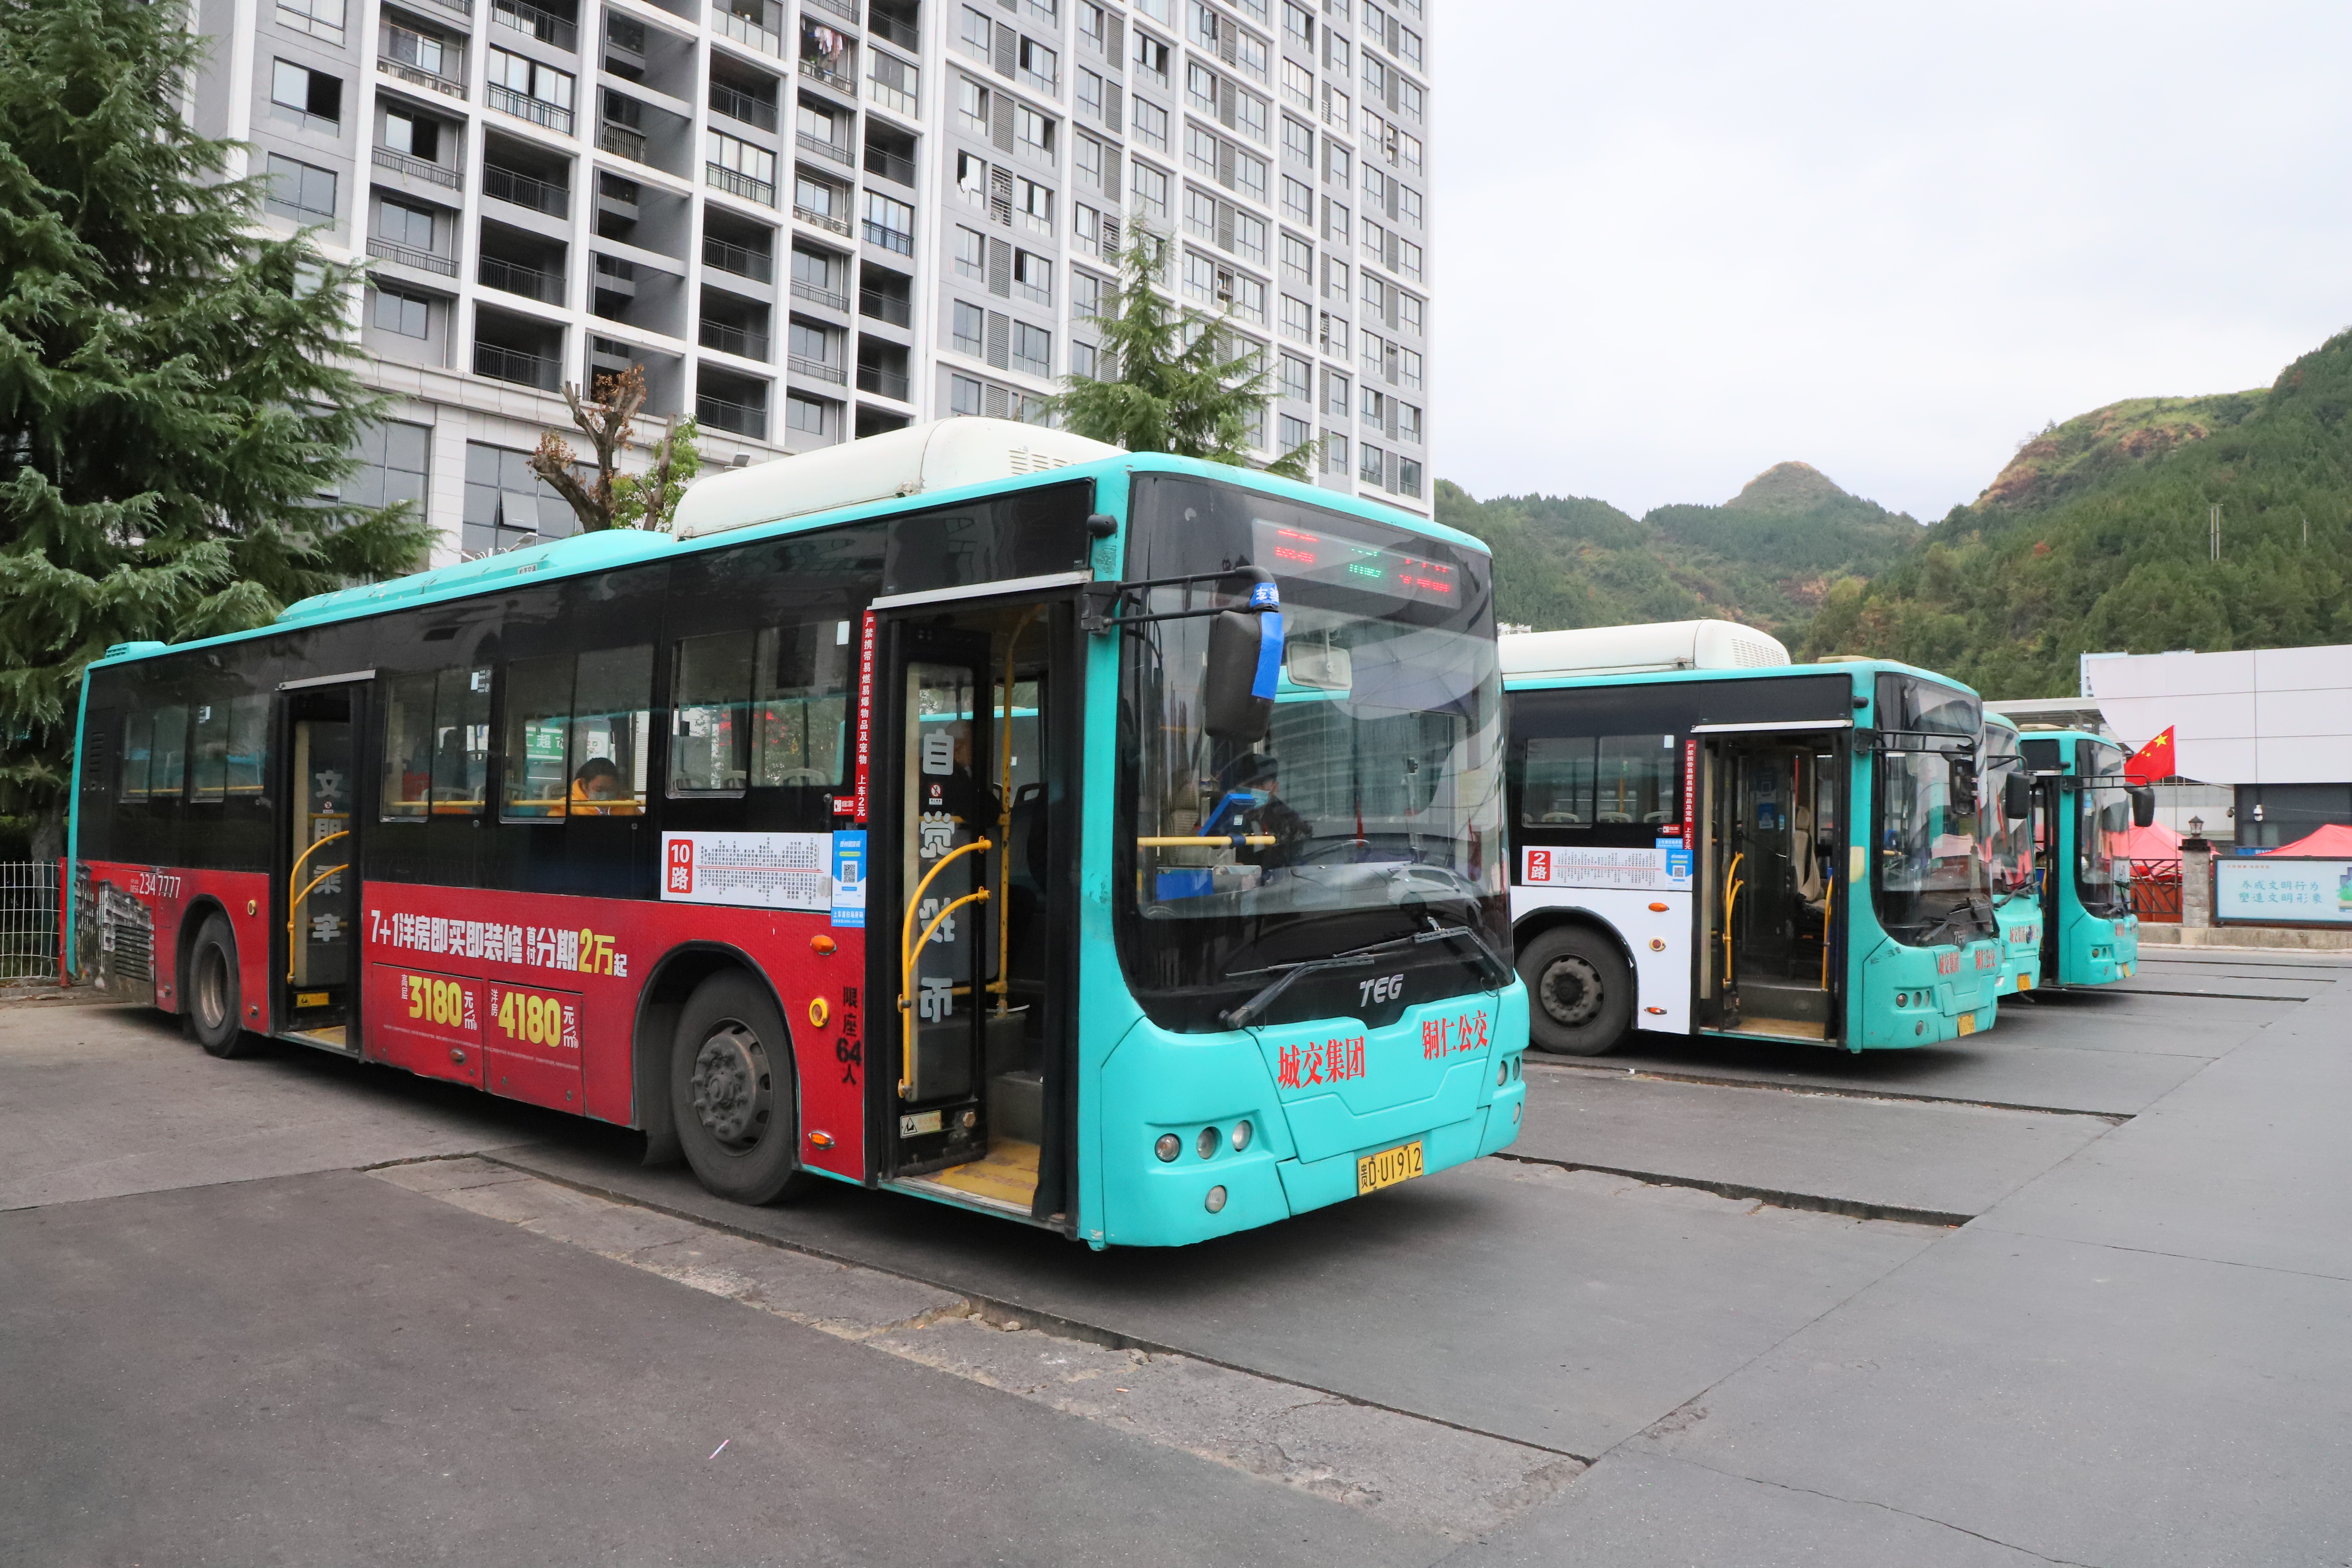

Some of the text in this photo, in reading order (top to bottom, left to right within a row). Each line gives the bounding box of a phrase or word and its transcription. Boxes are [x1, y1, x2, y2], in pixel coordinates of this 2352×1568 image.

[858, 617, 874, 764] 严禁携带易燃易爆物品及宠物
[857, 775, 866, 816] 上车2元
[1685, 744, 1694, 822] 严禁携带易燃易爆物品及宠物
[312, 770, 343, 942] 文明乘车
[919, 729, 956, 1023] 自觉投币
[2239, 892, 2323, 904] 塑造文明形象
[2242, 880, 2318, 891] 养成文明行为
[371, 910, 523, 965] 7+1洋房即买即装修
[401, 974, 408, 1000] 高层
[409, 975, 462, 1027] 3180
[491, 988, 498, 1017] 洋房
[498, 991, 561, 1047] 4180
[1360, 974, 1404, 1007] TEG
[836, 986, 862, 1086] 限座64人
[1421, 1009, 1488, 1060] 铜仁公交
[1277, 1035, 1365, 1090] 城交集团
